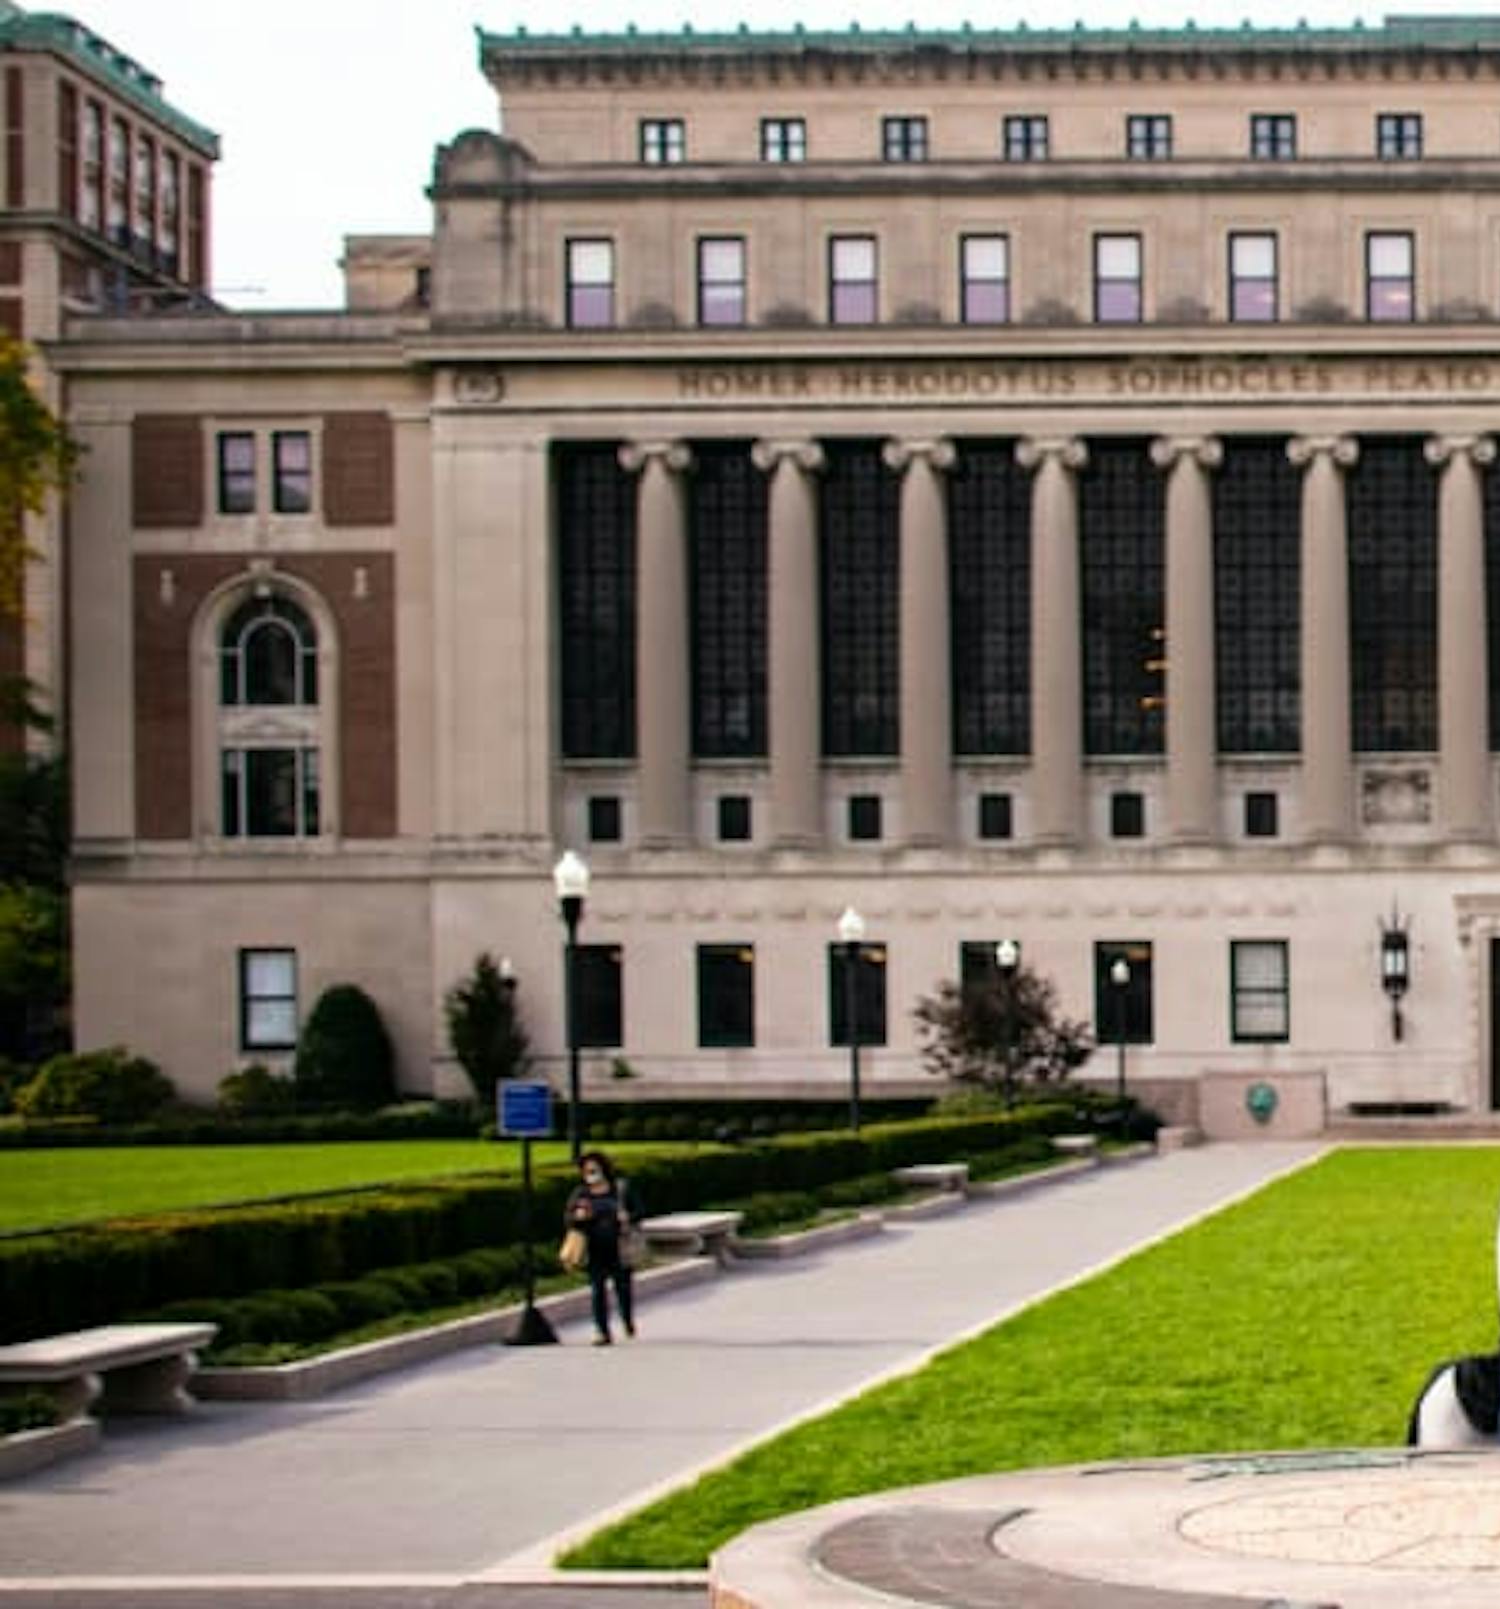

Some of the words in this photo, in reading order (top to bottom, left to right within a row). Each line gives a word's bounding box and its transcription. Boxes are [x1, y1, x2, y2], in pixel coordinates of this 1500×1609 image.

[677, 370, 810, 396] HOMER
[839, 369, 1077, 395] HERODOTUS
[1105, 367, 1333, 393] SOPHOCLES
[1365, 366, 1491, 391] PLATO
